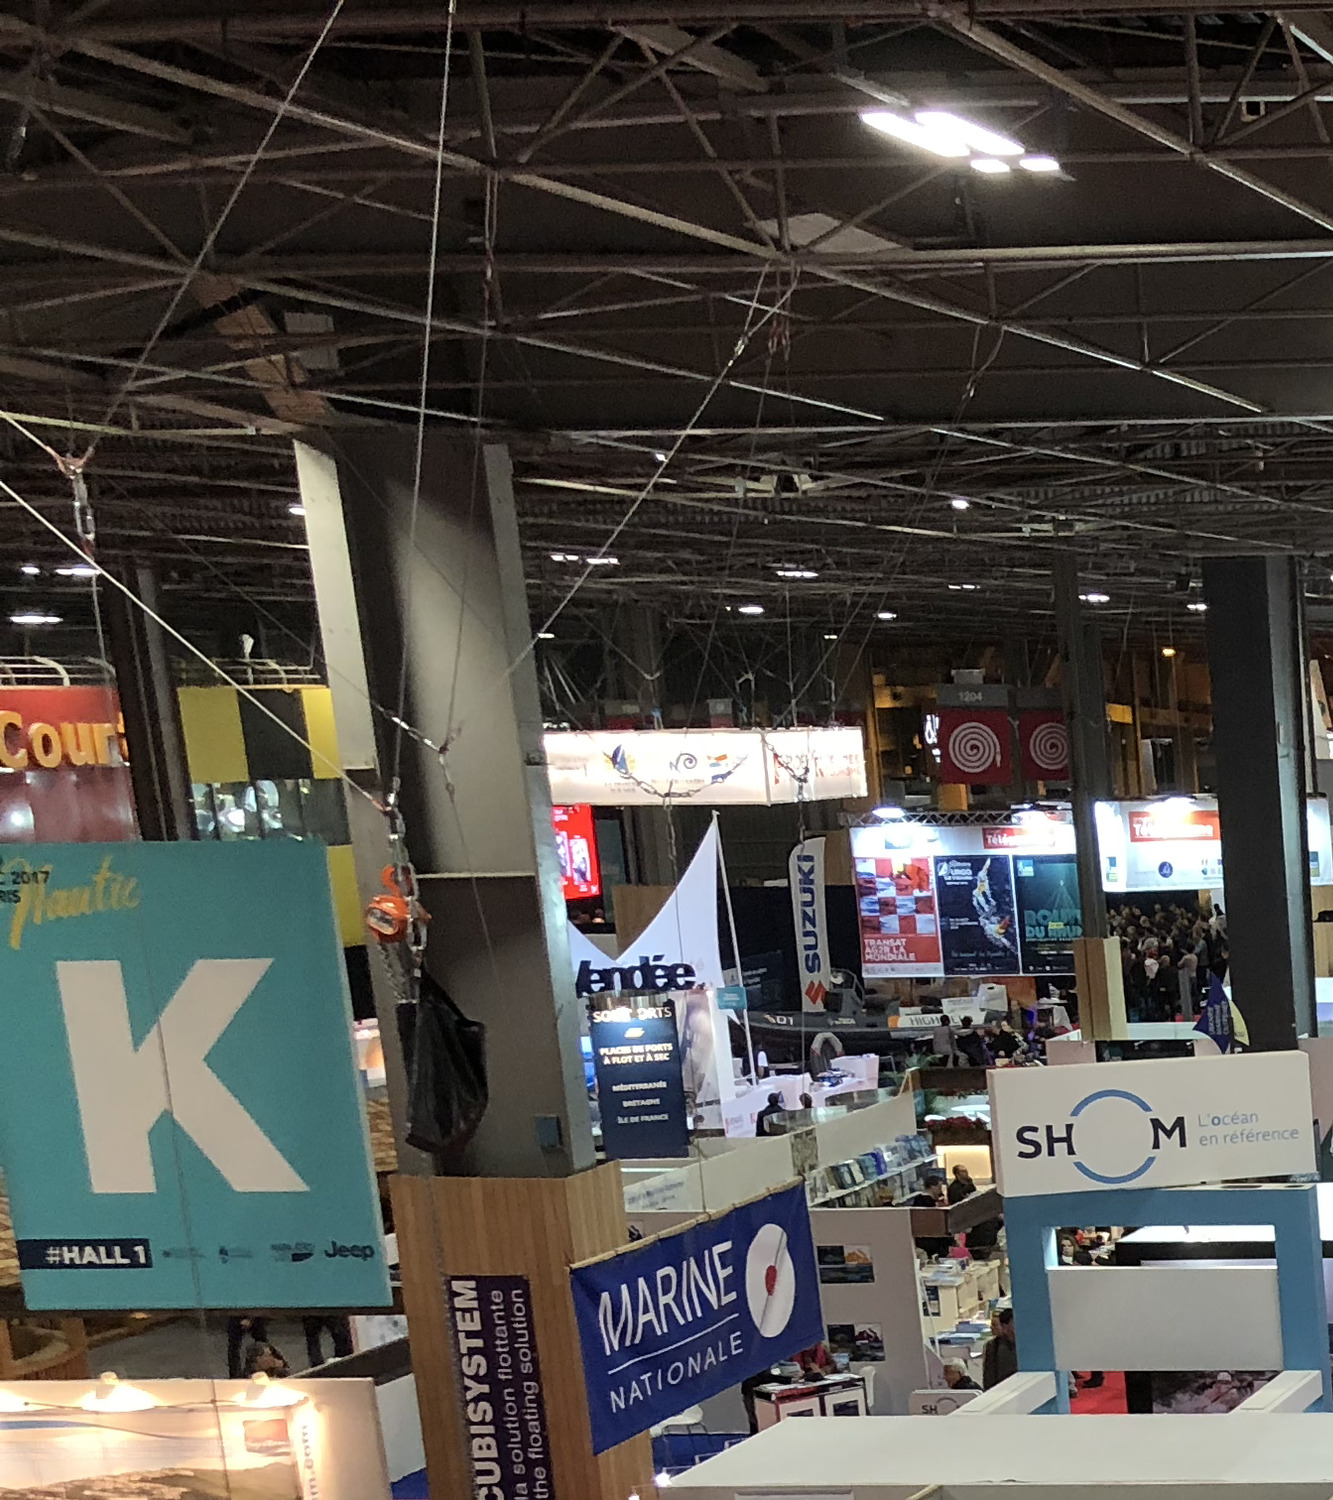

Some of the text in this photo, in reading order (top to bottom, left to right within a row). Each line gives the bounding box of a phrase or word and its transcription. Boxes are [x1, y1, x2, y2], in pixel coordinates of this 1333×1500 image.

[11, 870, 50, 885] 2017
[802, 853, 822, 974] SUZUKI
[864, 938, 907, 946] TRANSAT
[612, 1055, 632, 1064] FLOT
[654, 1052, 670, 1061] SEC
[645, 1043, 673, 1054] PORTS
[56, 958, 311, 1193] K
[1198, 1110, 1259, 1127] L'océan
[1199, 1128, 1299, 1146] en référence
[46, 1239, 375, 1266] #HALL 1 Jeep
[599, 1239, 738, 1357] MARINE
[609, 1331, 746, 1414] NATIONALE
[490, 1290, 529, 1500] la solution flottante
[511, 1289, 550, 1500] the floating solution
